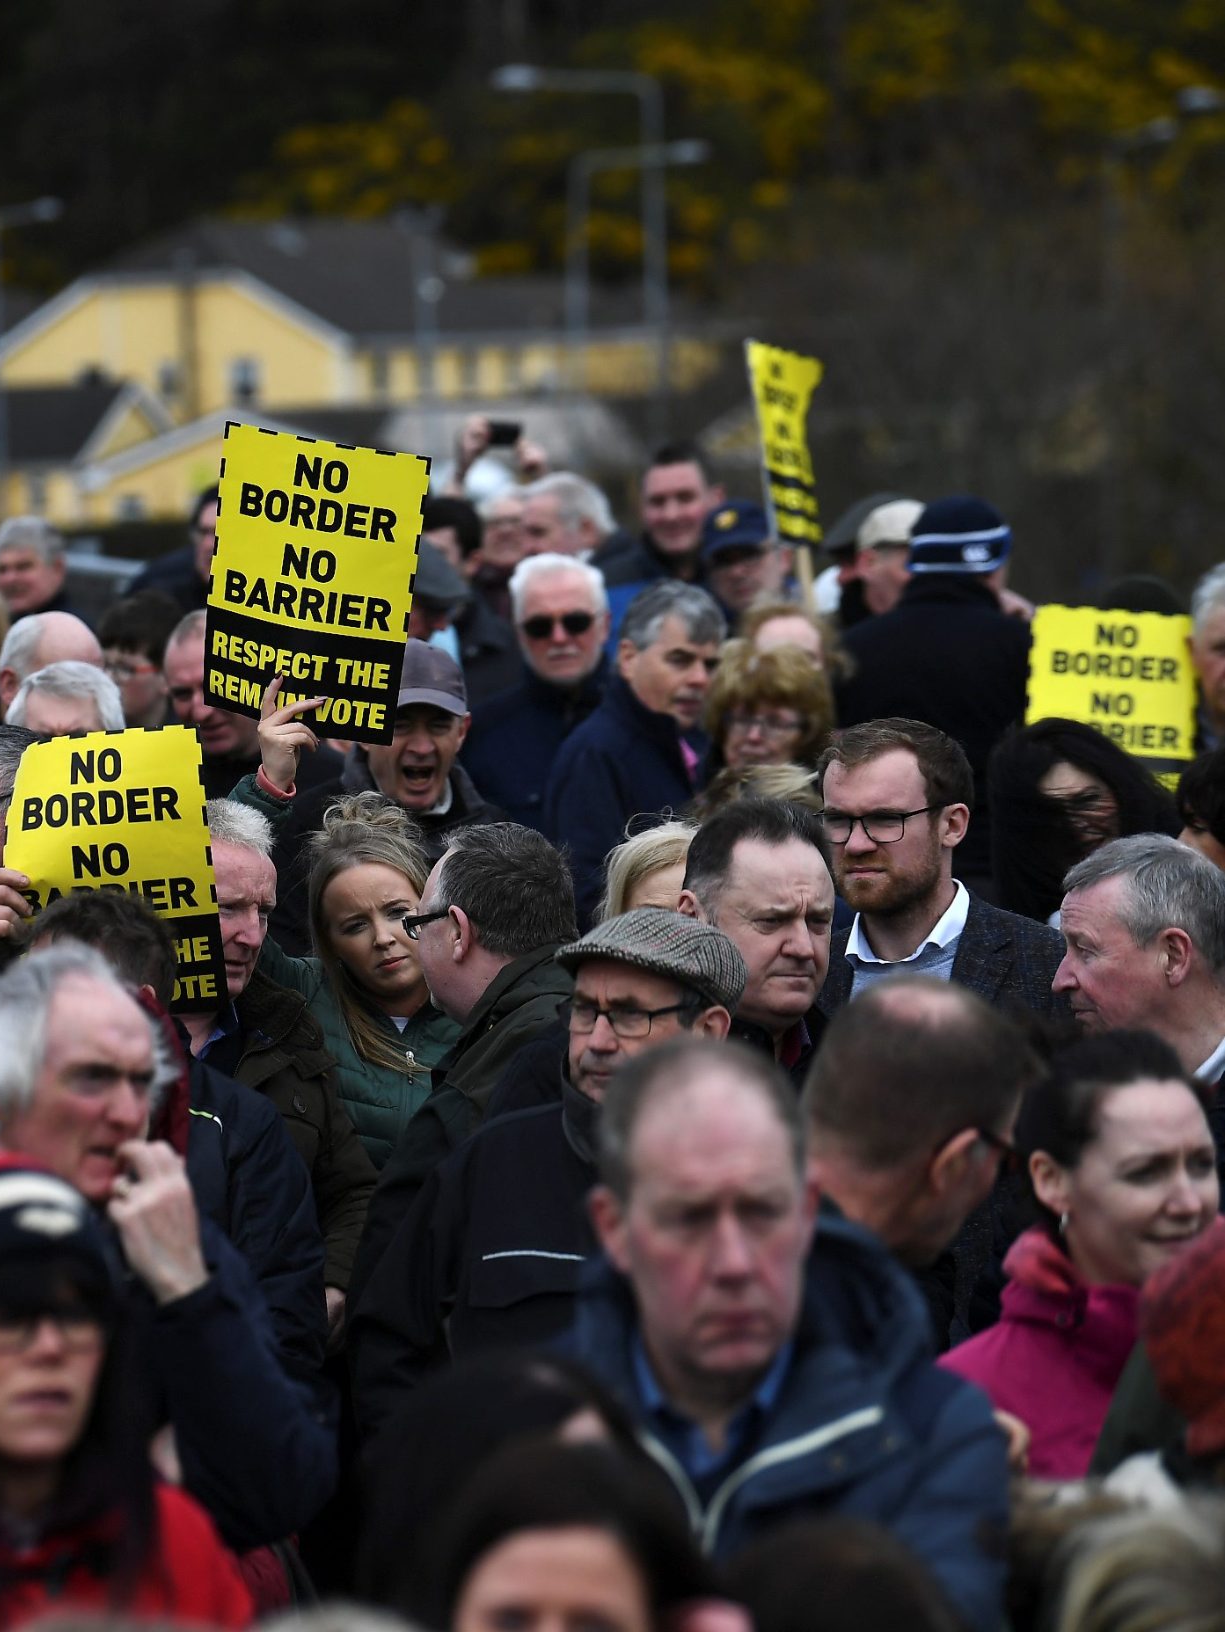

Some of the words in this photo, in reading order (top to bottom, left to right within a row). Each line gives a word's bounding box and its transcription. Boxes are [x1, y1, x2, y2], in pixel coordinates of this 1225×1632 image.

[293, 453, 349, 494] NO
[239, 482, 397, 543] BORDER
[280, 543, 337, 583] NO
[224, 569, 392, 632] BARRIER
[1095, 623, 1139, 648] NO
[212, 630, 329, 681] RESPECT
[336, 658, 391, 690] THE
[1051, 650, 1180, 681] BORDER
[209, 669, 306, 720] REMIN
[315, 696, 387, 730] VOTE
[1090, 691, 1134, 717] NO
[70, 748, 122, 785] NO
[21, 786, 181, 831] BORDER
[71, 842, 130, 879] NO
[173, 936, 211, 964] HE
